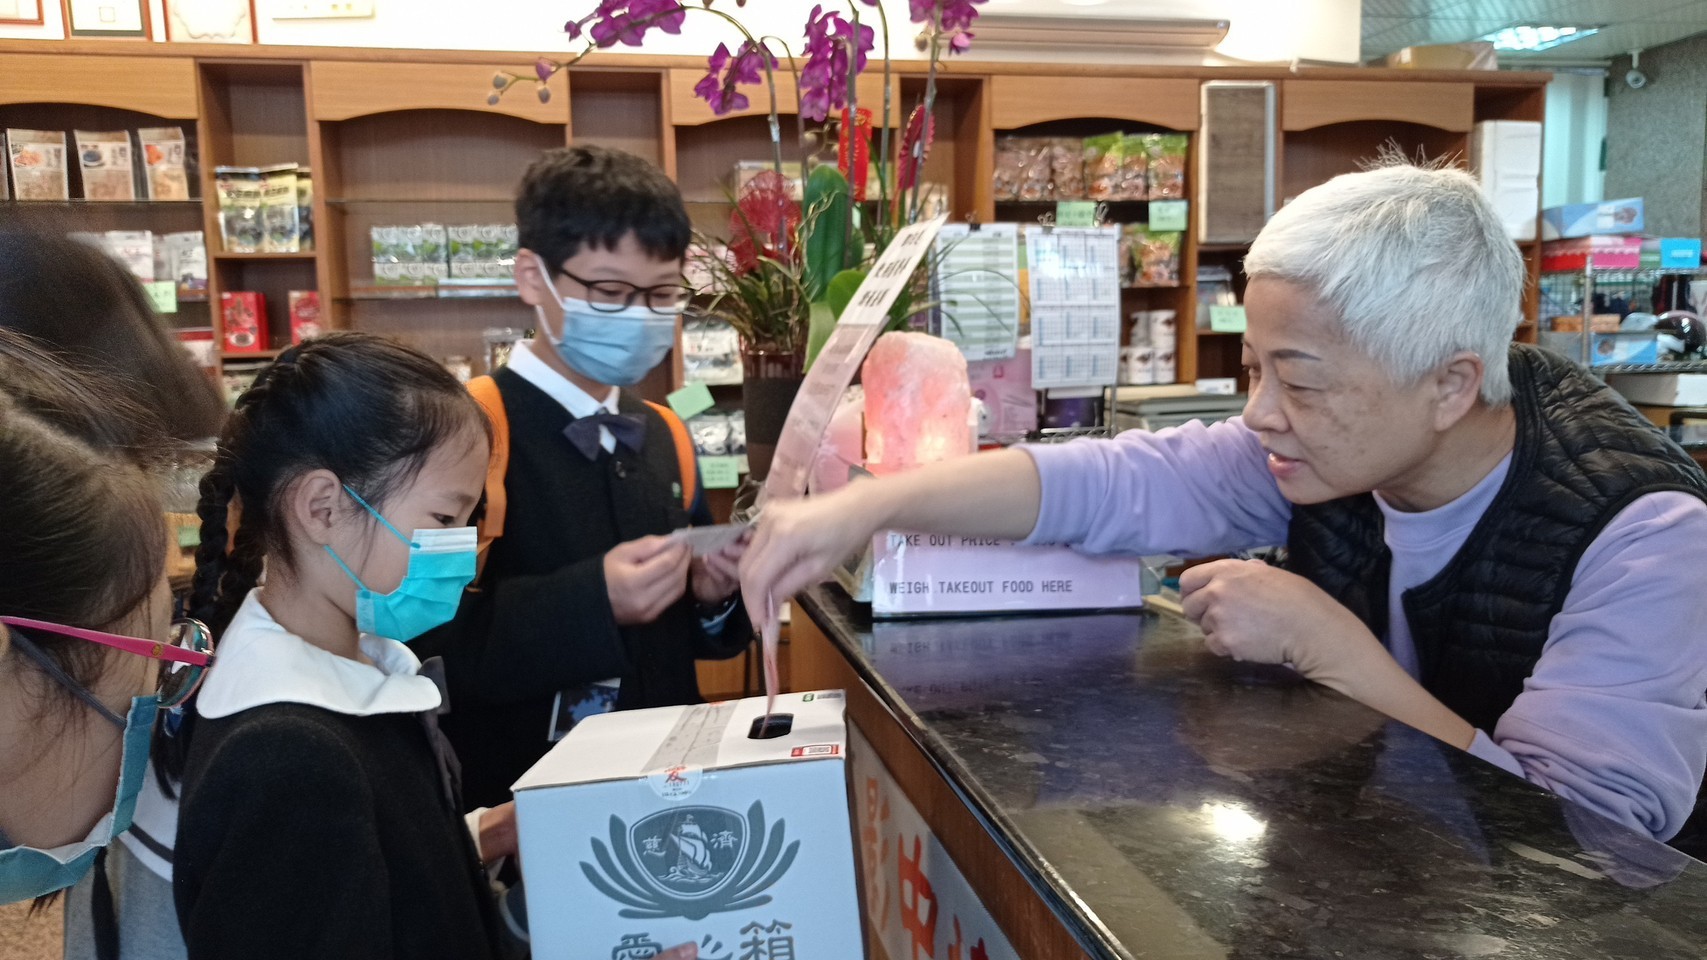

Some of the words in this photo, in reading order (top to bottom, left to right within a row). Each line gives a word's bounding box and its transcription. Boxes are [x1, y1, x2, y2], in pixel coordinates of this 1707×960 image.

[889, 534, 920, 546] TAKE
[929, 534, 953, 546] OUT
[890, 581, 929, 594] WEIGH
[938, 581, 994, 594] TAKEOUT
[1002, 580, 1033, 593] FOOD
[1041, 580, 1073, 592] HERE
